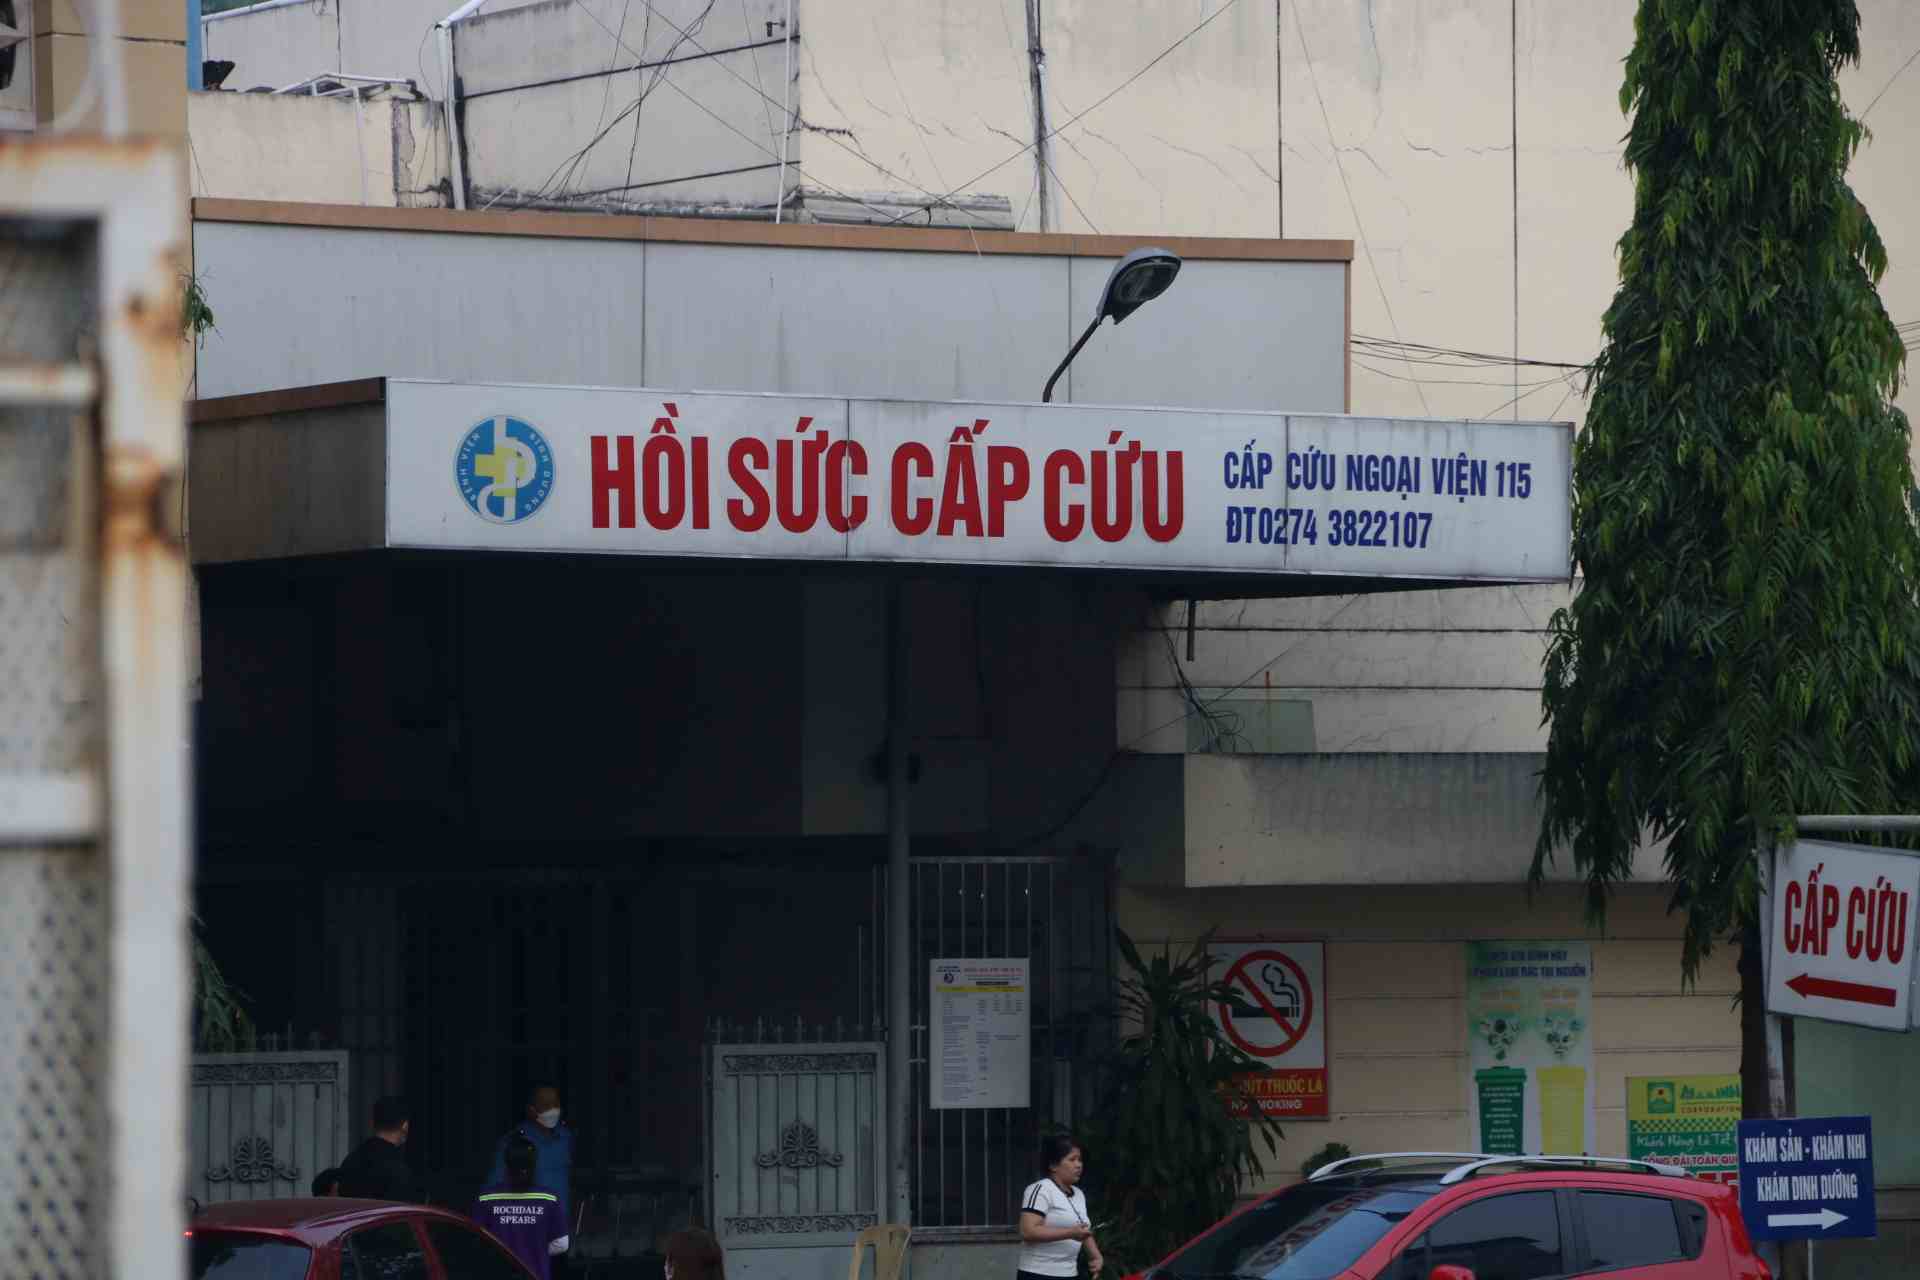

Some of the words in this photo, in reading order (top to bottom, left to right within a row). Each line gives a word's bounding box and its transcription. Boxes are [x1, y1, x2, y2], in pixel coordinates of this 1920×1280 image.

[590, 402, 710, 531] HỒI
[726, 416, 869, 534] SỨC
[890, 419, 1031, 538] CẤP
[1043, 430, 1185, 543] CỨU
[1224, 438, 1273, 490] CẤP
[1286, 445, 1337, 491] CỨU
[1346, 454, 1421, 500] NGOẠI
[1432, 452, 1488, 503] VIỆN
[1495, 461, 1532, 499] 115
[1328, 509, 1433, 549] 3822107
[1784, 862, 1840, 957] CẤP
[1846, 875, 1909, 965] CỨU
[1744, 1131, 1778, 1163] KHÁM
[1812, 1129, 1845, 1161] KHÁM
[1846, 1133, 1867, 1159] NHI
[1757, 1170, 1790, 1202] KHÁM
[1791, 1175, 1819, 1201] DINH
[1820, 1168, 1859, 1200] DƯỠNG
[493, 1205, 545, 1216] ROCHDALE
[499, 1215, 538, 1225] SPEARS
